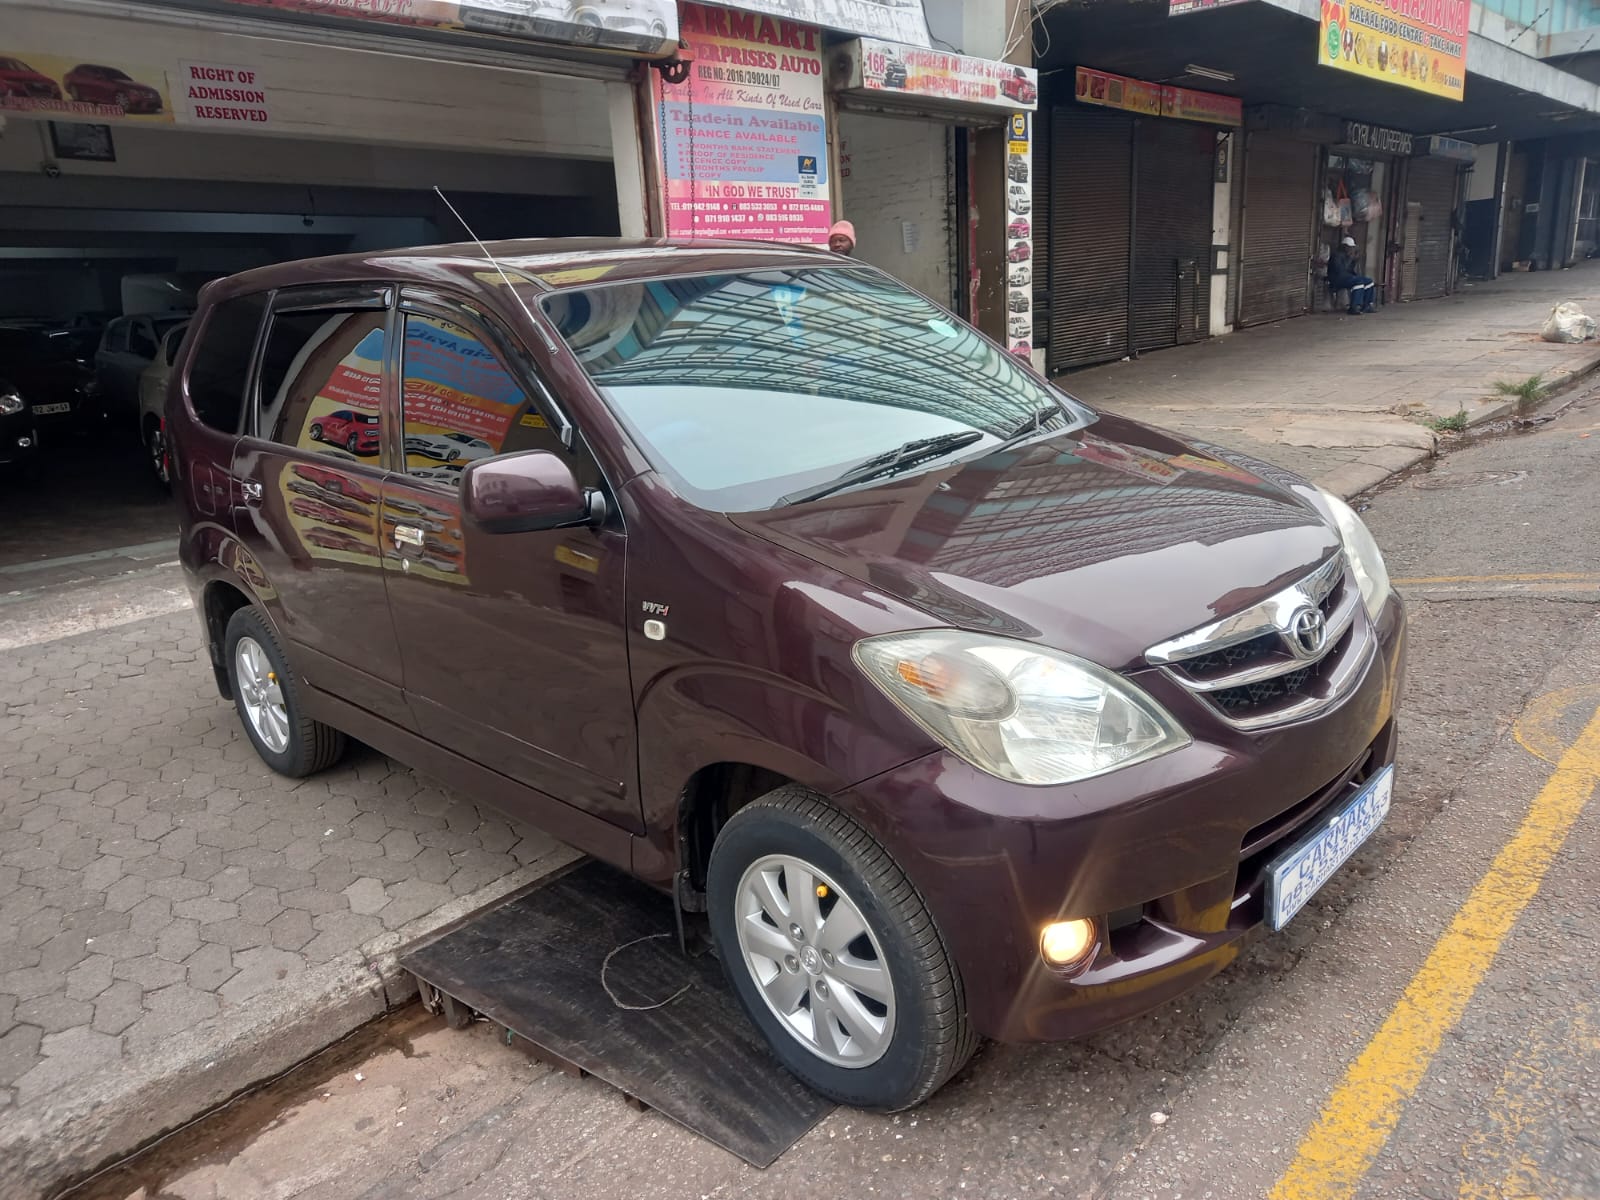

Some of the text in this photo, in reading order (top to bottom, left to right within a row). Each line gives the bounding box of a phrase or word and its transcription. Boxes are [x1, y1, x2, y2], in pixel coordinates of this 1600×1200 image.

[682, 2, 819, 51] ARMART
[1380, 15, 1398, 37] FOOD
[1399, 22, 1423, 44] CENTRE
[698, 65, 712, 79] REG
[714, 67, 726, 80] NO:
[779, 54, 821, 76] AUTO
[867, 52, 885, 73] 168
[190, 66, 255, 84] RIGHT OF
[188, 86, 265, 103] ADMISSION
[717, 88, 733, 100] All
[736, 89, 763, 104] Kinds
[766, 93, 776, 110] Of
[779, 95, 801, 108] Used
[803, 97, 822, 111] Cars
[195, 105, 268, 122] RESERVED
[670, 109, 821, 133] Trade-in Available
[675, 128, 797, 143] FINANCE AVAILABLE
[723, 186, 745, 197] GOD
[748, 186, 763, 197] WE
[1299, 785, 1378, 879] CARMART
[1281, 872, 1313, 912] 083
